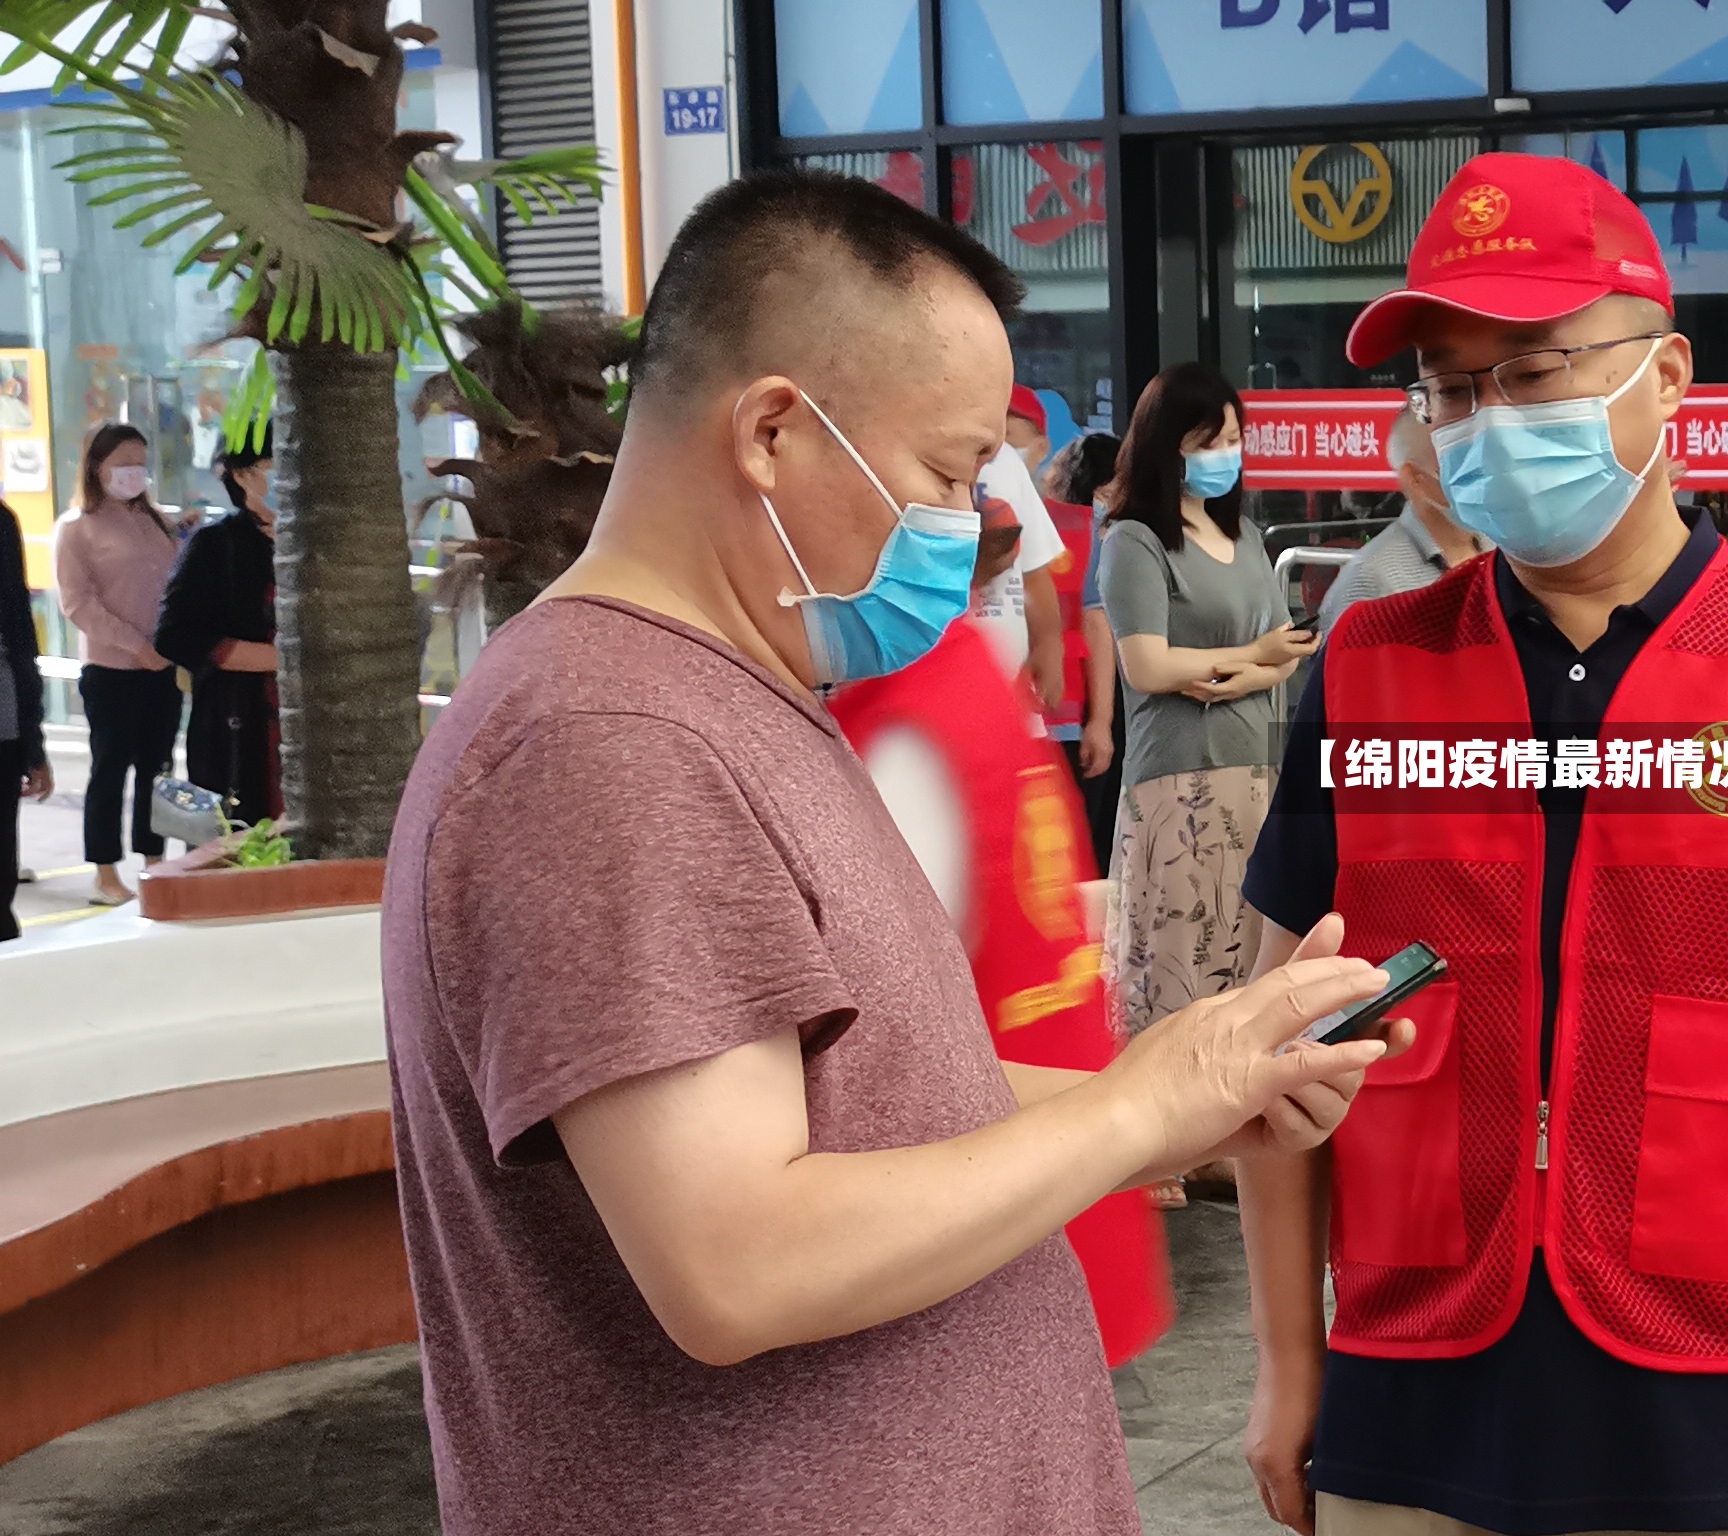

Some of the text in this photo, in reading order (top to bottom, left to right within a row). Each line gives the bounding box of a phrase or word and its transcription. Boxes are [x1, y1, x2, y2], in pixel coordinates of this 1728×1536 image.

[672, 107, 718, 129] 19-17
[1314, 420, 1379, 458] 当心碰头
